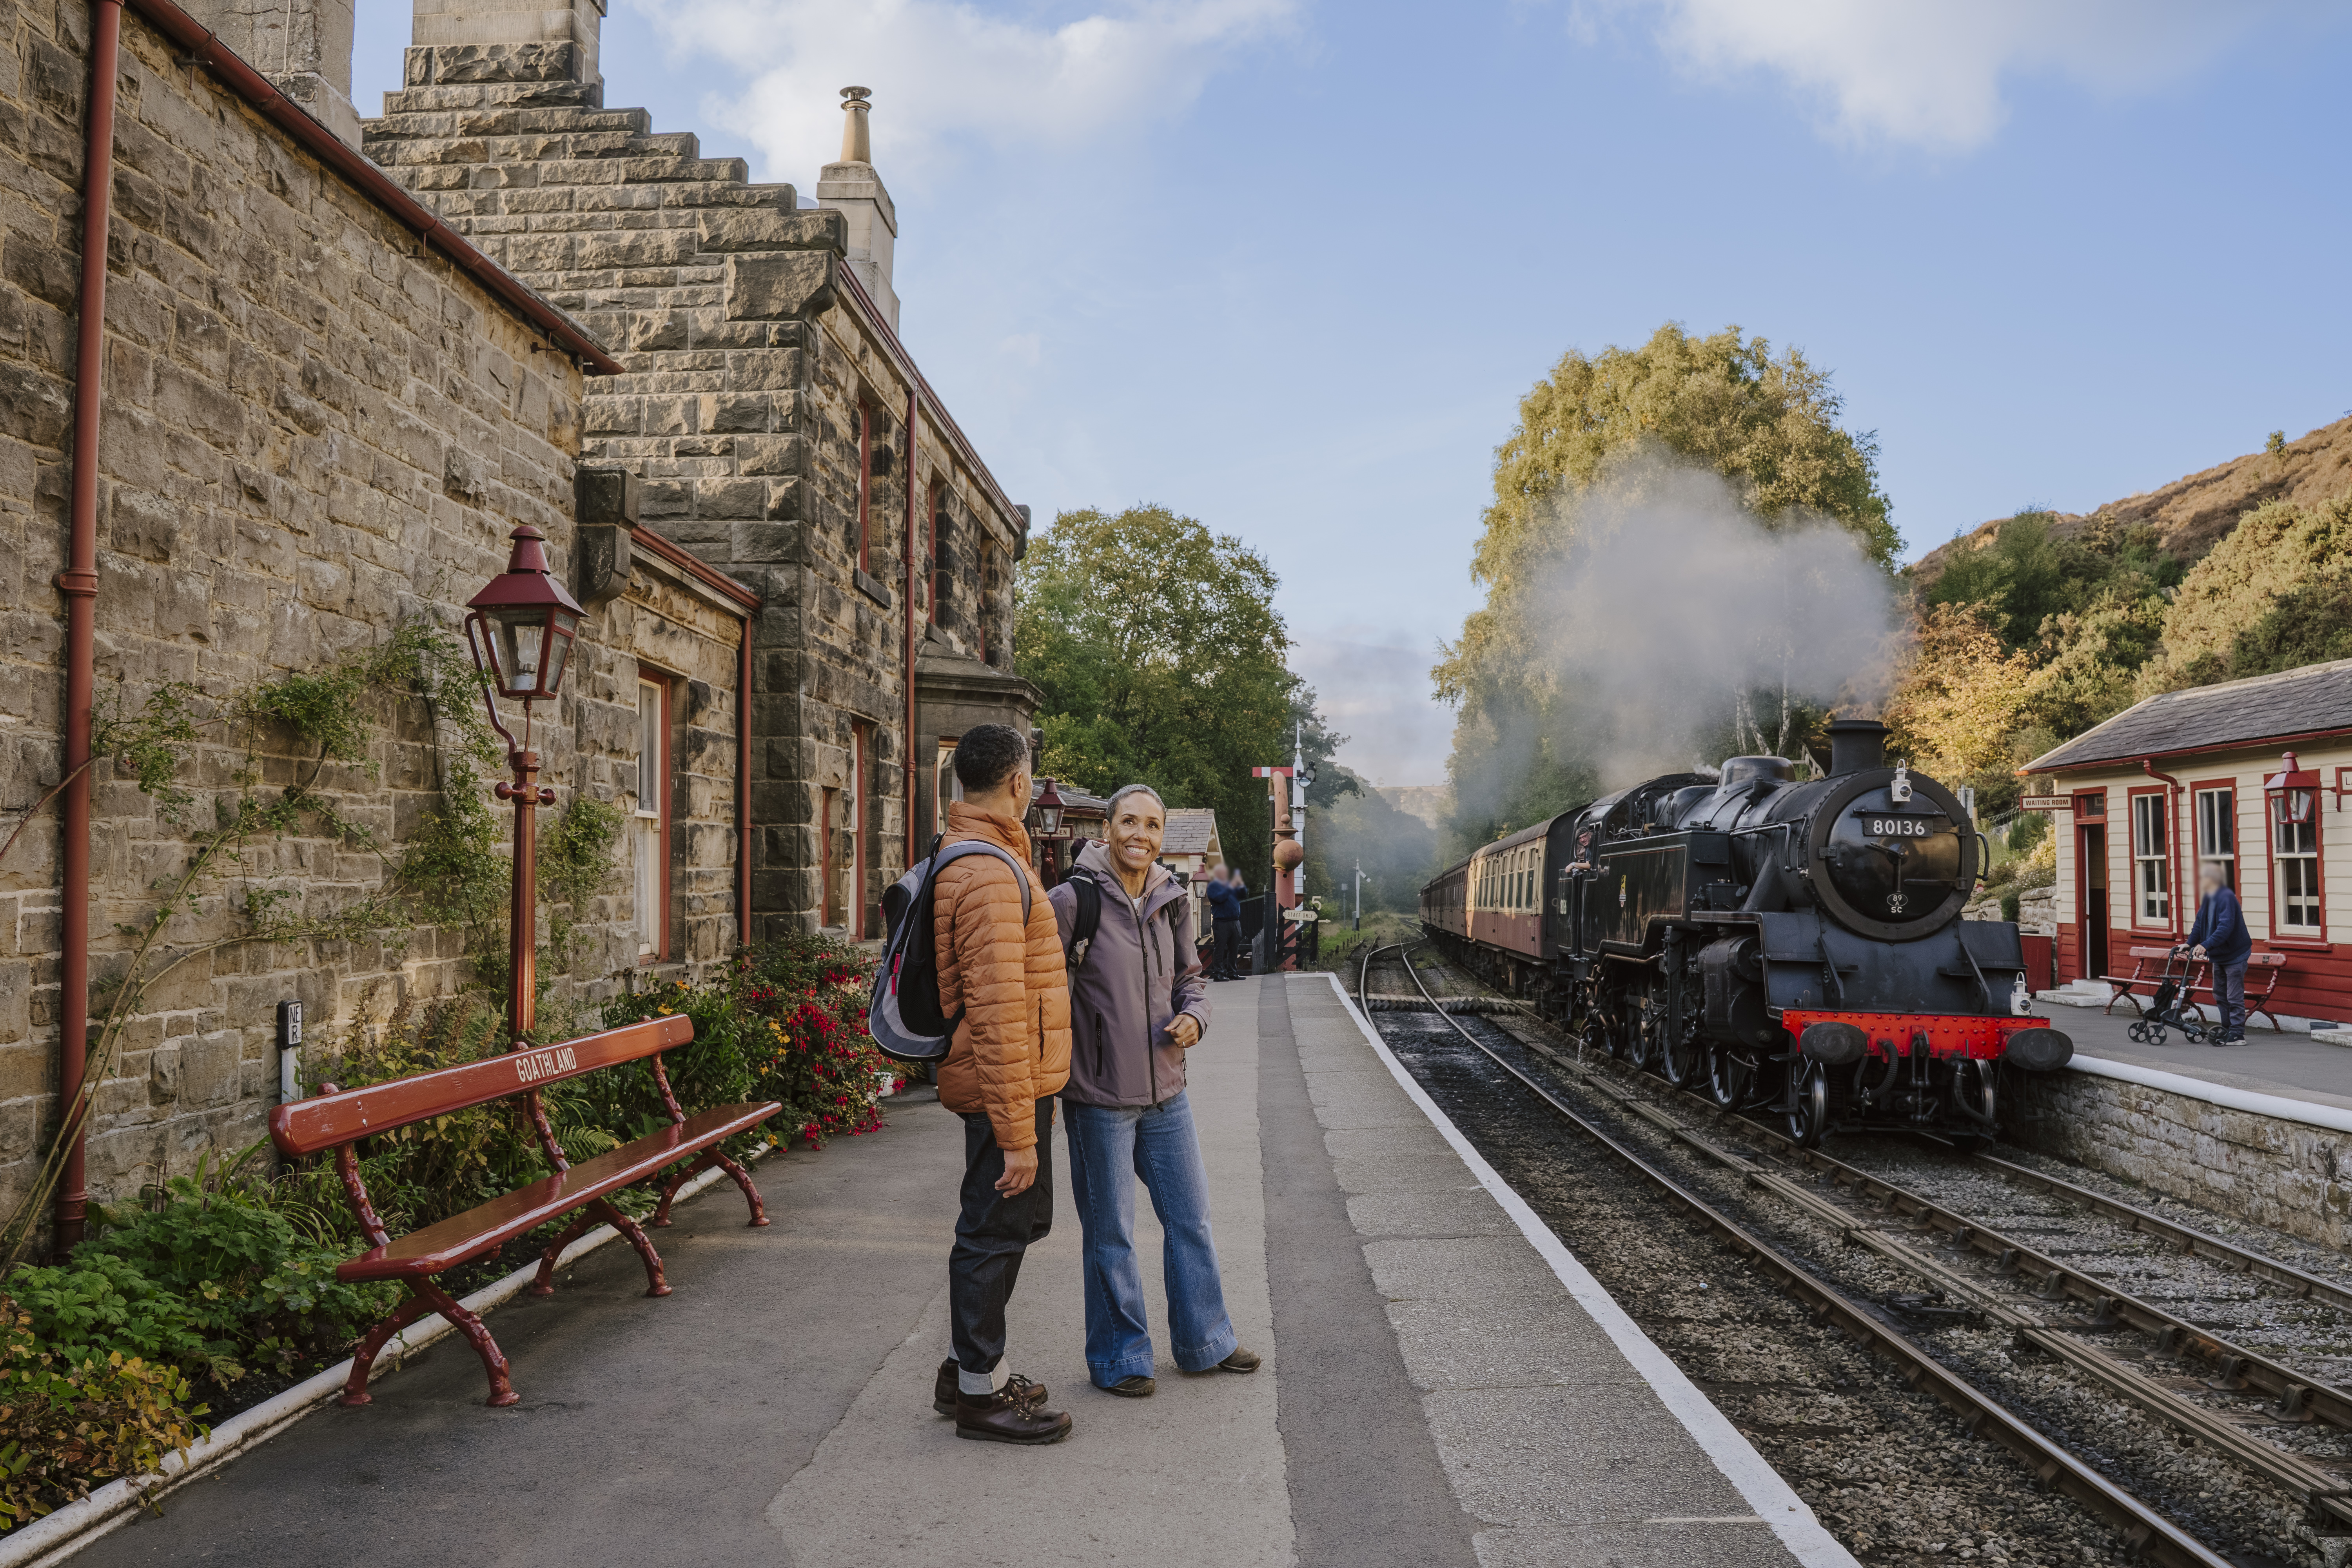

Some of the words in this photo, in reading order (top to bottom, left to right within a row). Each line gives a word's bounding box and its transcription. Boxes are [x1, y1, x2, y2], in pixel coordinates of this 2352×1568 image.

[2345, 777, 2352, 785] L
[1873, 820, 1925, 835] 80136
[1311, 896, 1321, 911] 5
[290, 1005, 300, 1024] NE
[292, 1025, 298, 1043] R
[516, 1047, 577, 1082] GOATHLAND
